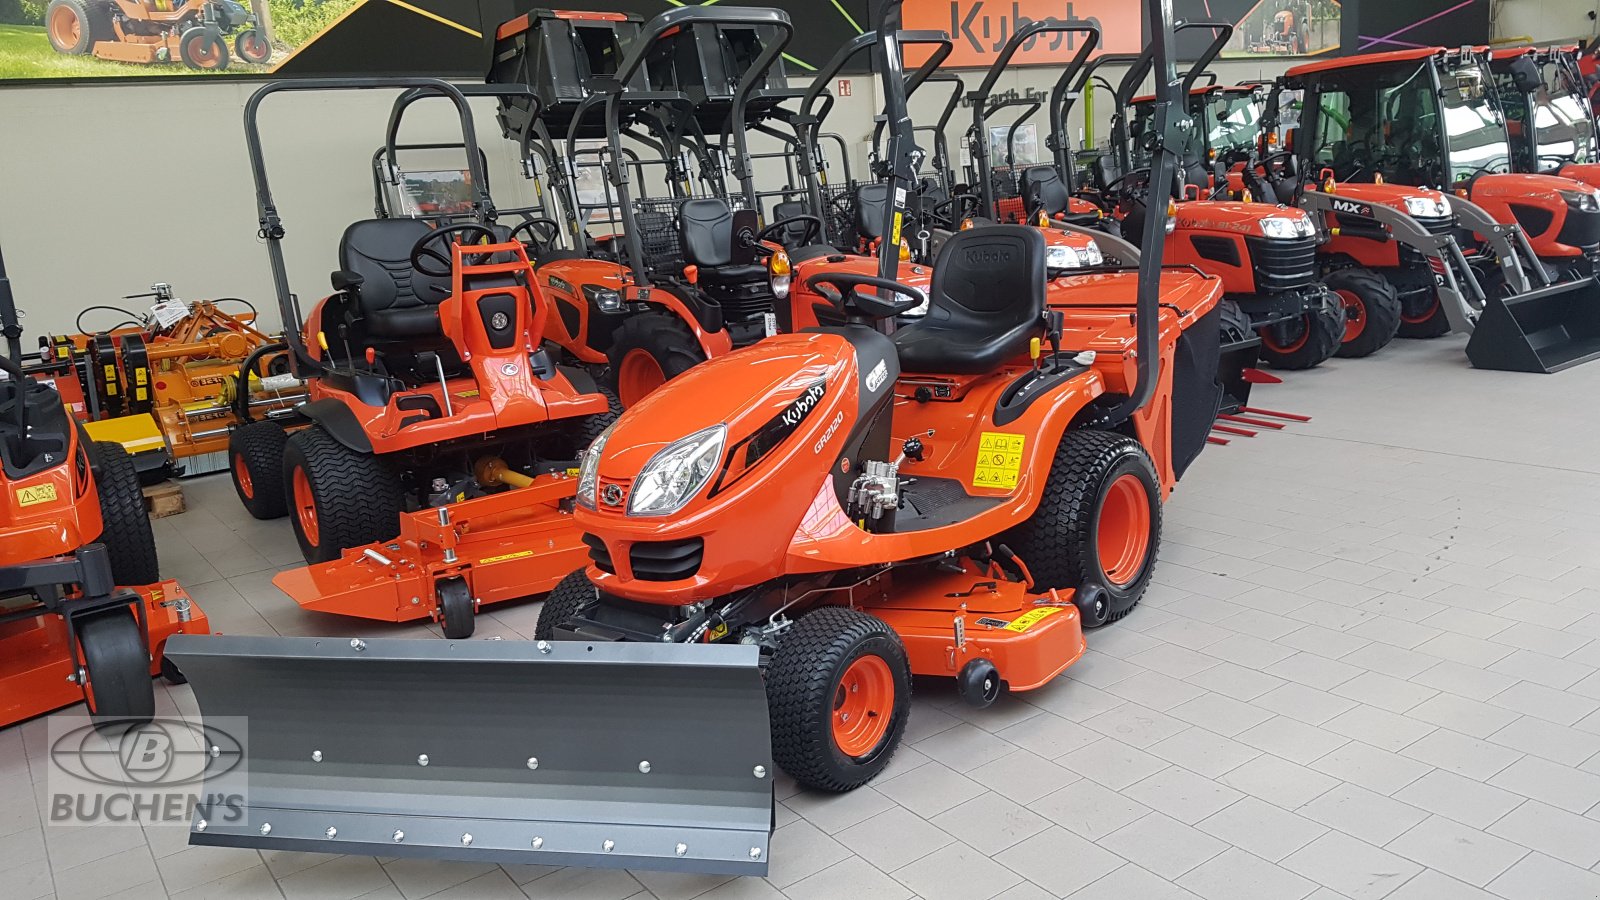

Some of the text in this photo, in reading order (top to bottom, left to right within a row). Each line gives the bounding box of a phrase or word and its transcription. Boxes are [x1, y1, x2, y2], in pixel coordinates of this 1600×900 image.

[951, 1, 1103, 53] Kubota
[1333, 200, 1361, 214] MX
[782, 384, 825, 426] Kubota
[814, 410, 844, 454] GR2120
